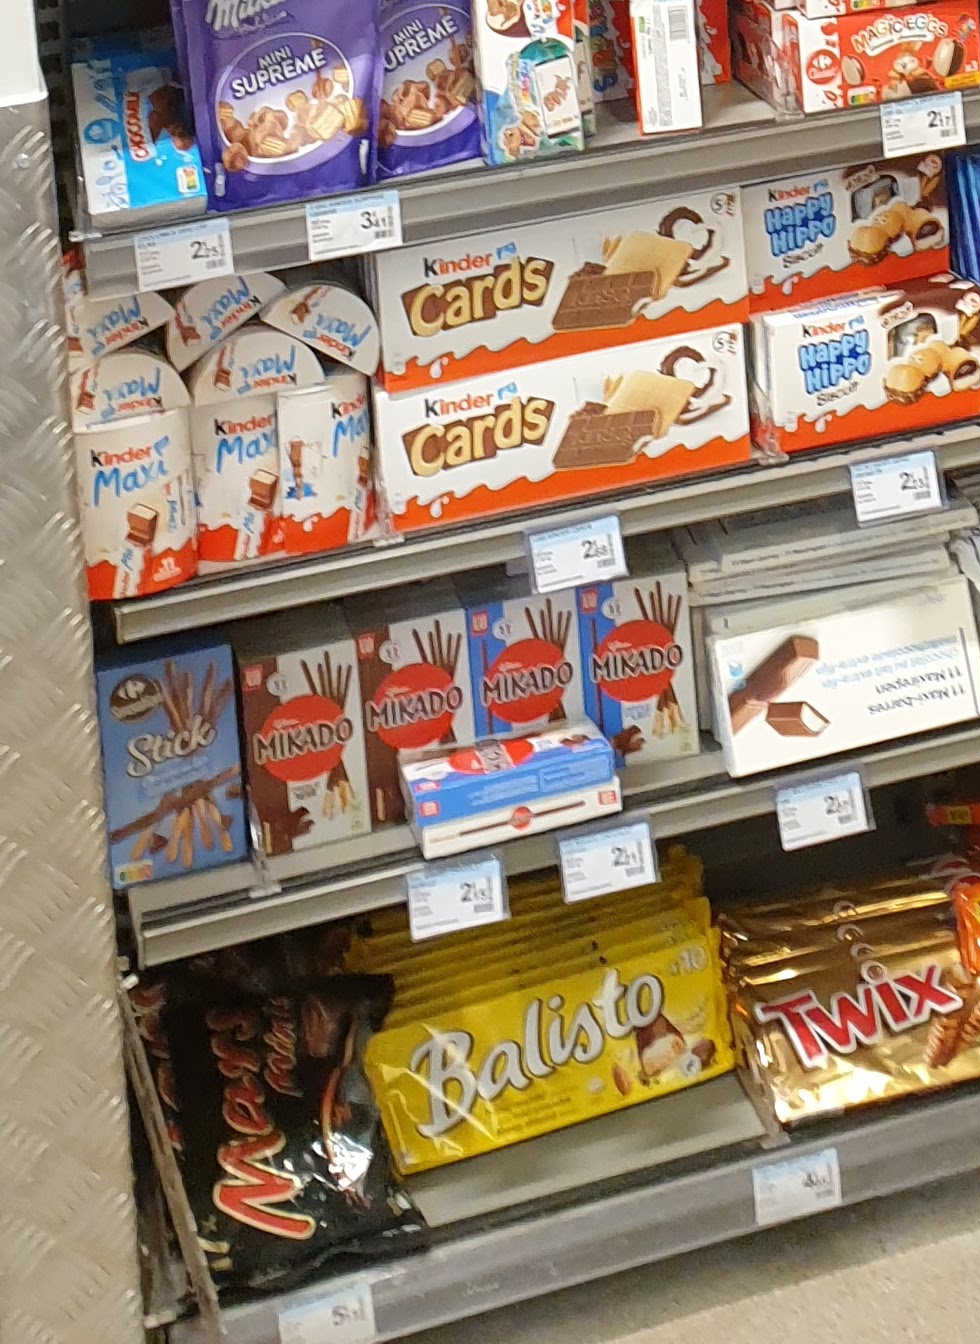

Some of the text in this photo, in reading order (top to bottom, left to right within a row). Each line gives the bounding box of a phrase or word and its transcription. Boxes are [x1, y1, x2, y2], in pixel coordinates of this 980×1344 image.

[258, 44, 292, 68] MINI
[394, 18, 424, 45] MINI
[851, 13, 948, 53] MAGIC EGGS
[231, 47, 327, 100] SUPREME
[409, 256, 549, 338] Cards
[409, 396, 549, 477] Cards
[93, 457, 169, 508] Maxi
[481, 660, 575, 708] MIKADO
[590, 643, 684, 685] MIKADO
[364, 684, 464, 733] MIKADO
[125, 714, 218, 779] Stick
[252, 716, 355, 765] MIKADO
[755, 962, 965, 1072] Twix
[408, 964, 665, 1140] Balisto
